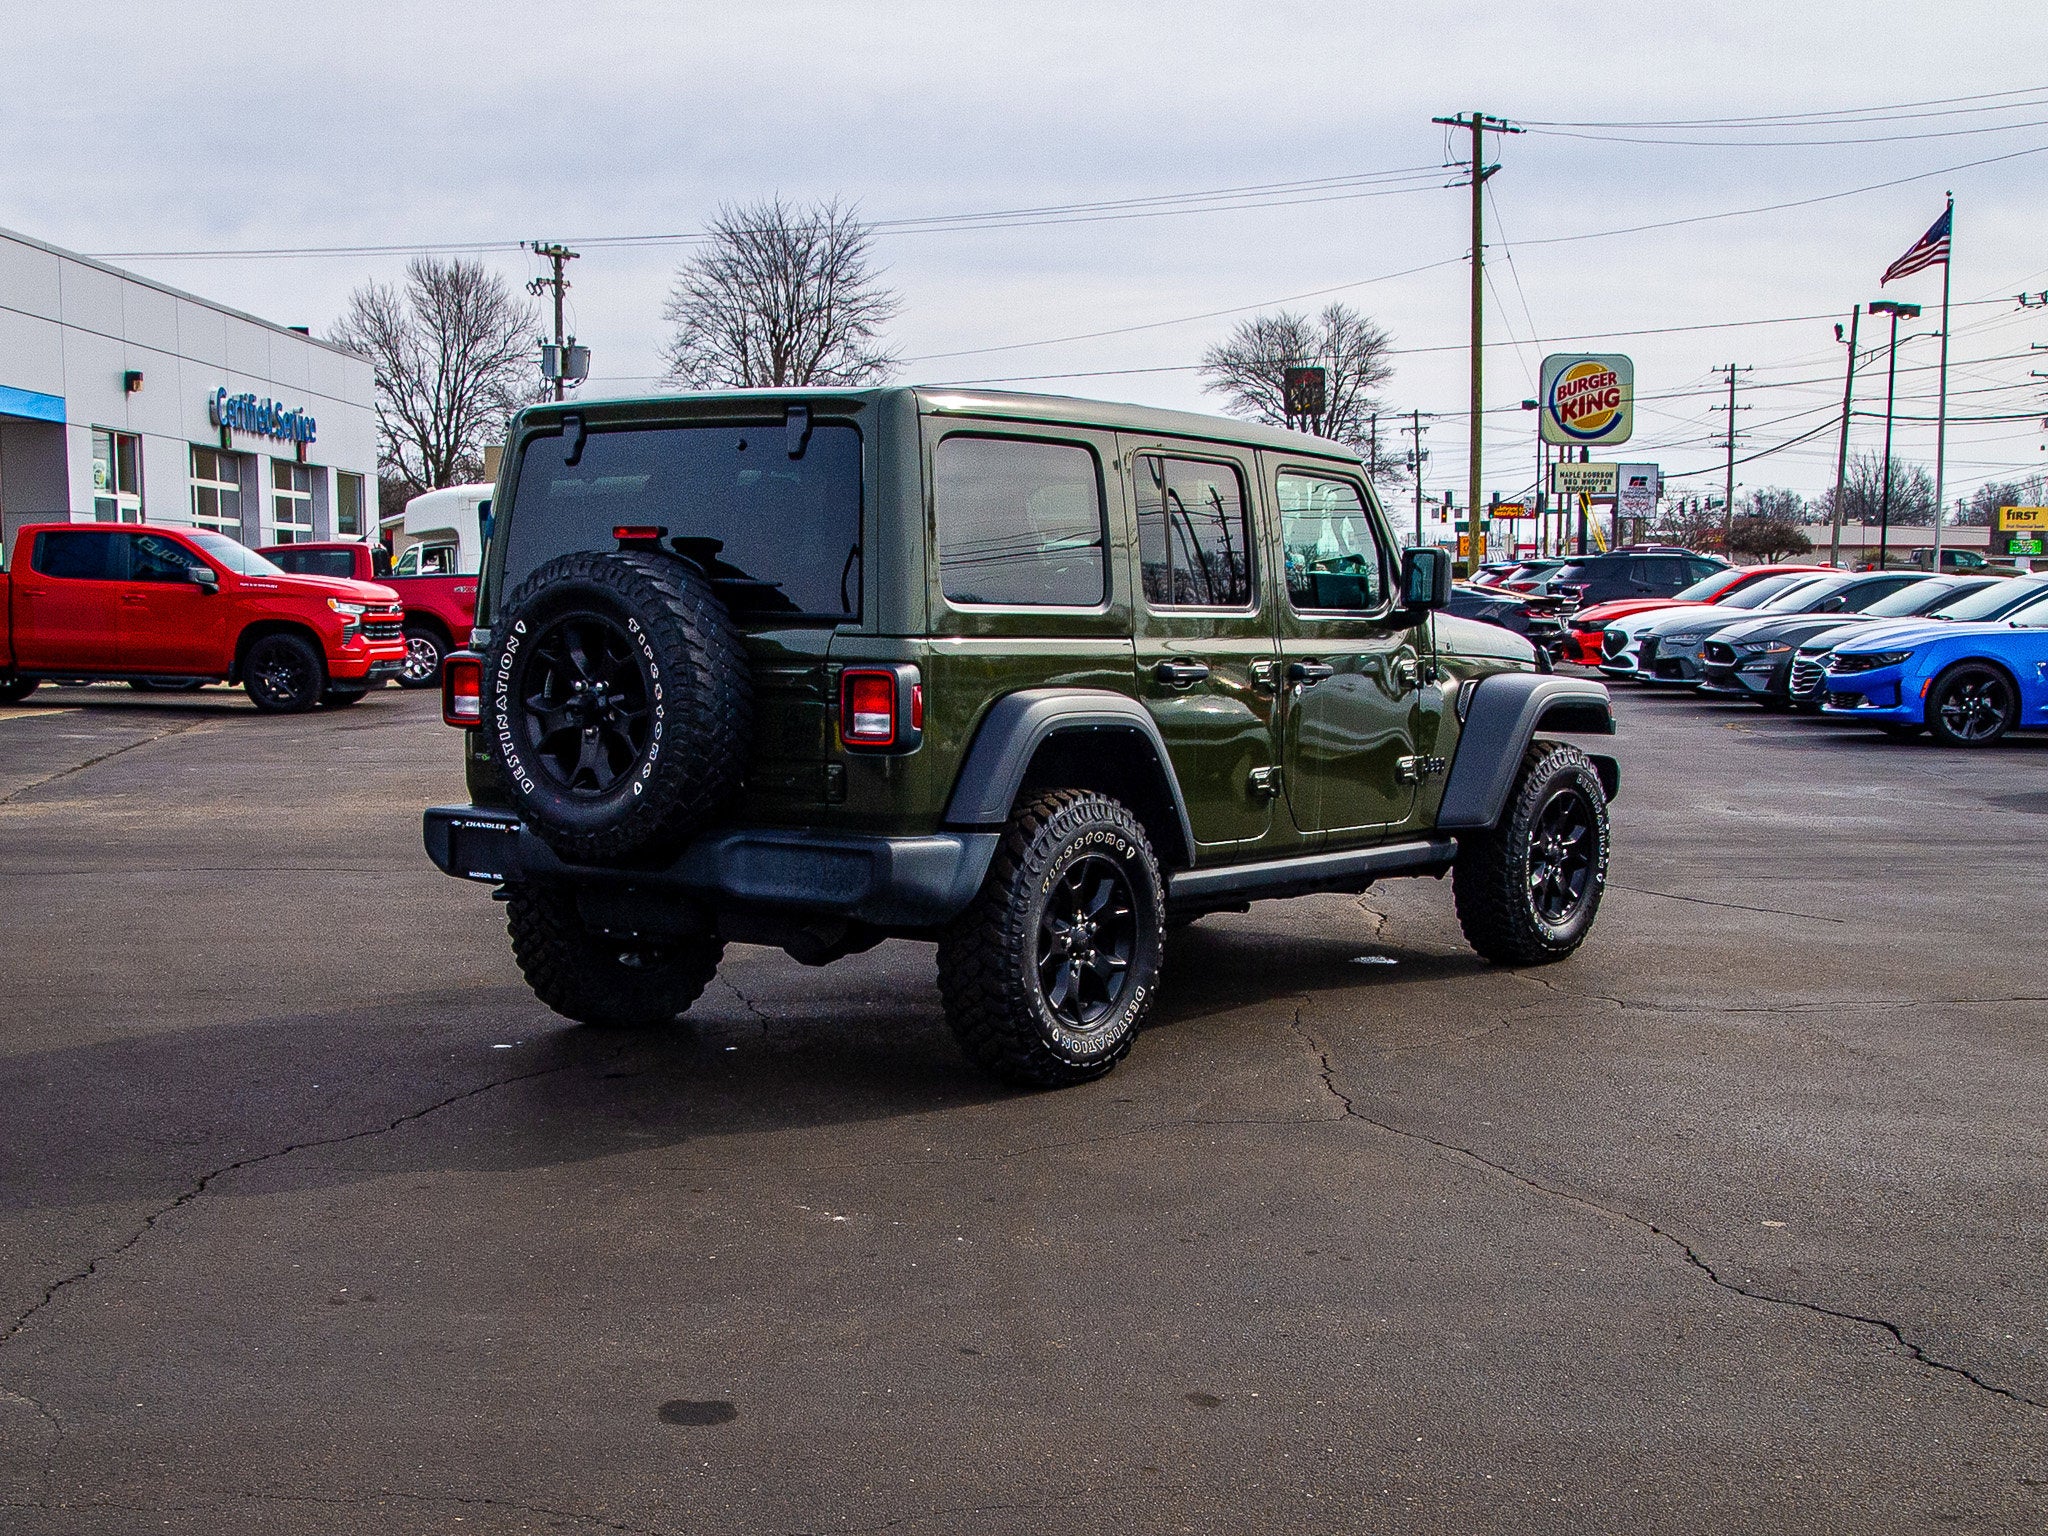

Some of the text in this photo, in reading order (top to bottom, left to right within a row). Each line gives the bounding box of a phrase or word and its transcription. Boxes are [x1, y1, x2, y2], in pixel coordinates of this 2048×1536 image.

[1557, 372, 1617, 402] BURGER
[1560, 387, 1621, 423] KING
[216, 386, 316, 443] Certified Service
[495, 635, 535, 795] DESTINATION
[465, 821, 506, 830] CHANDLER
[1061, 986, 1146, 1054] DESTINATION
